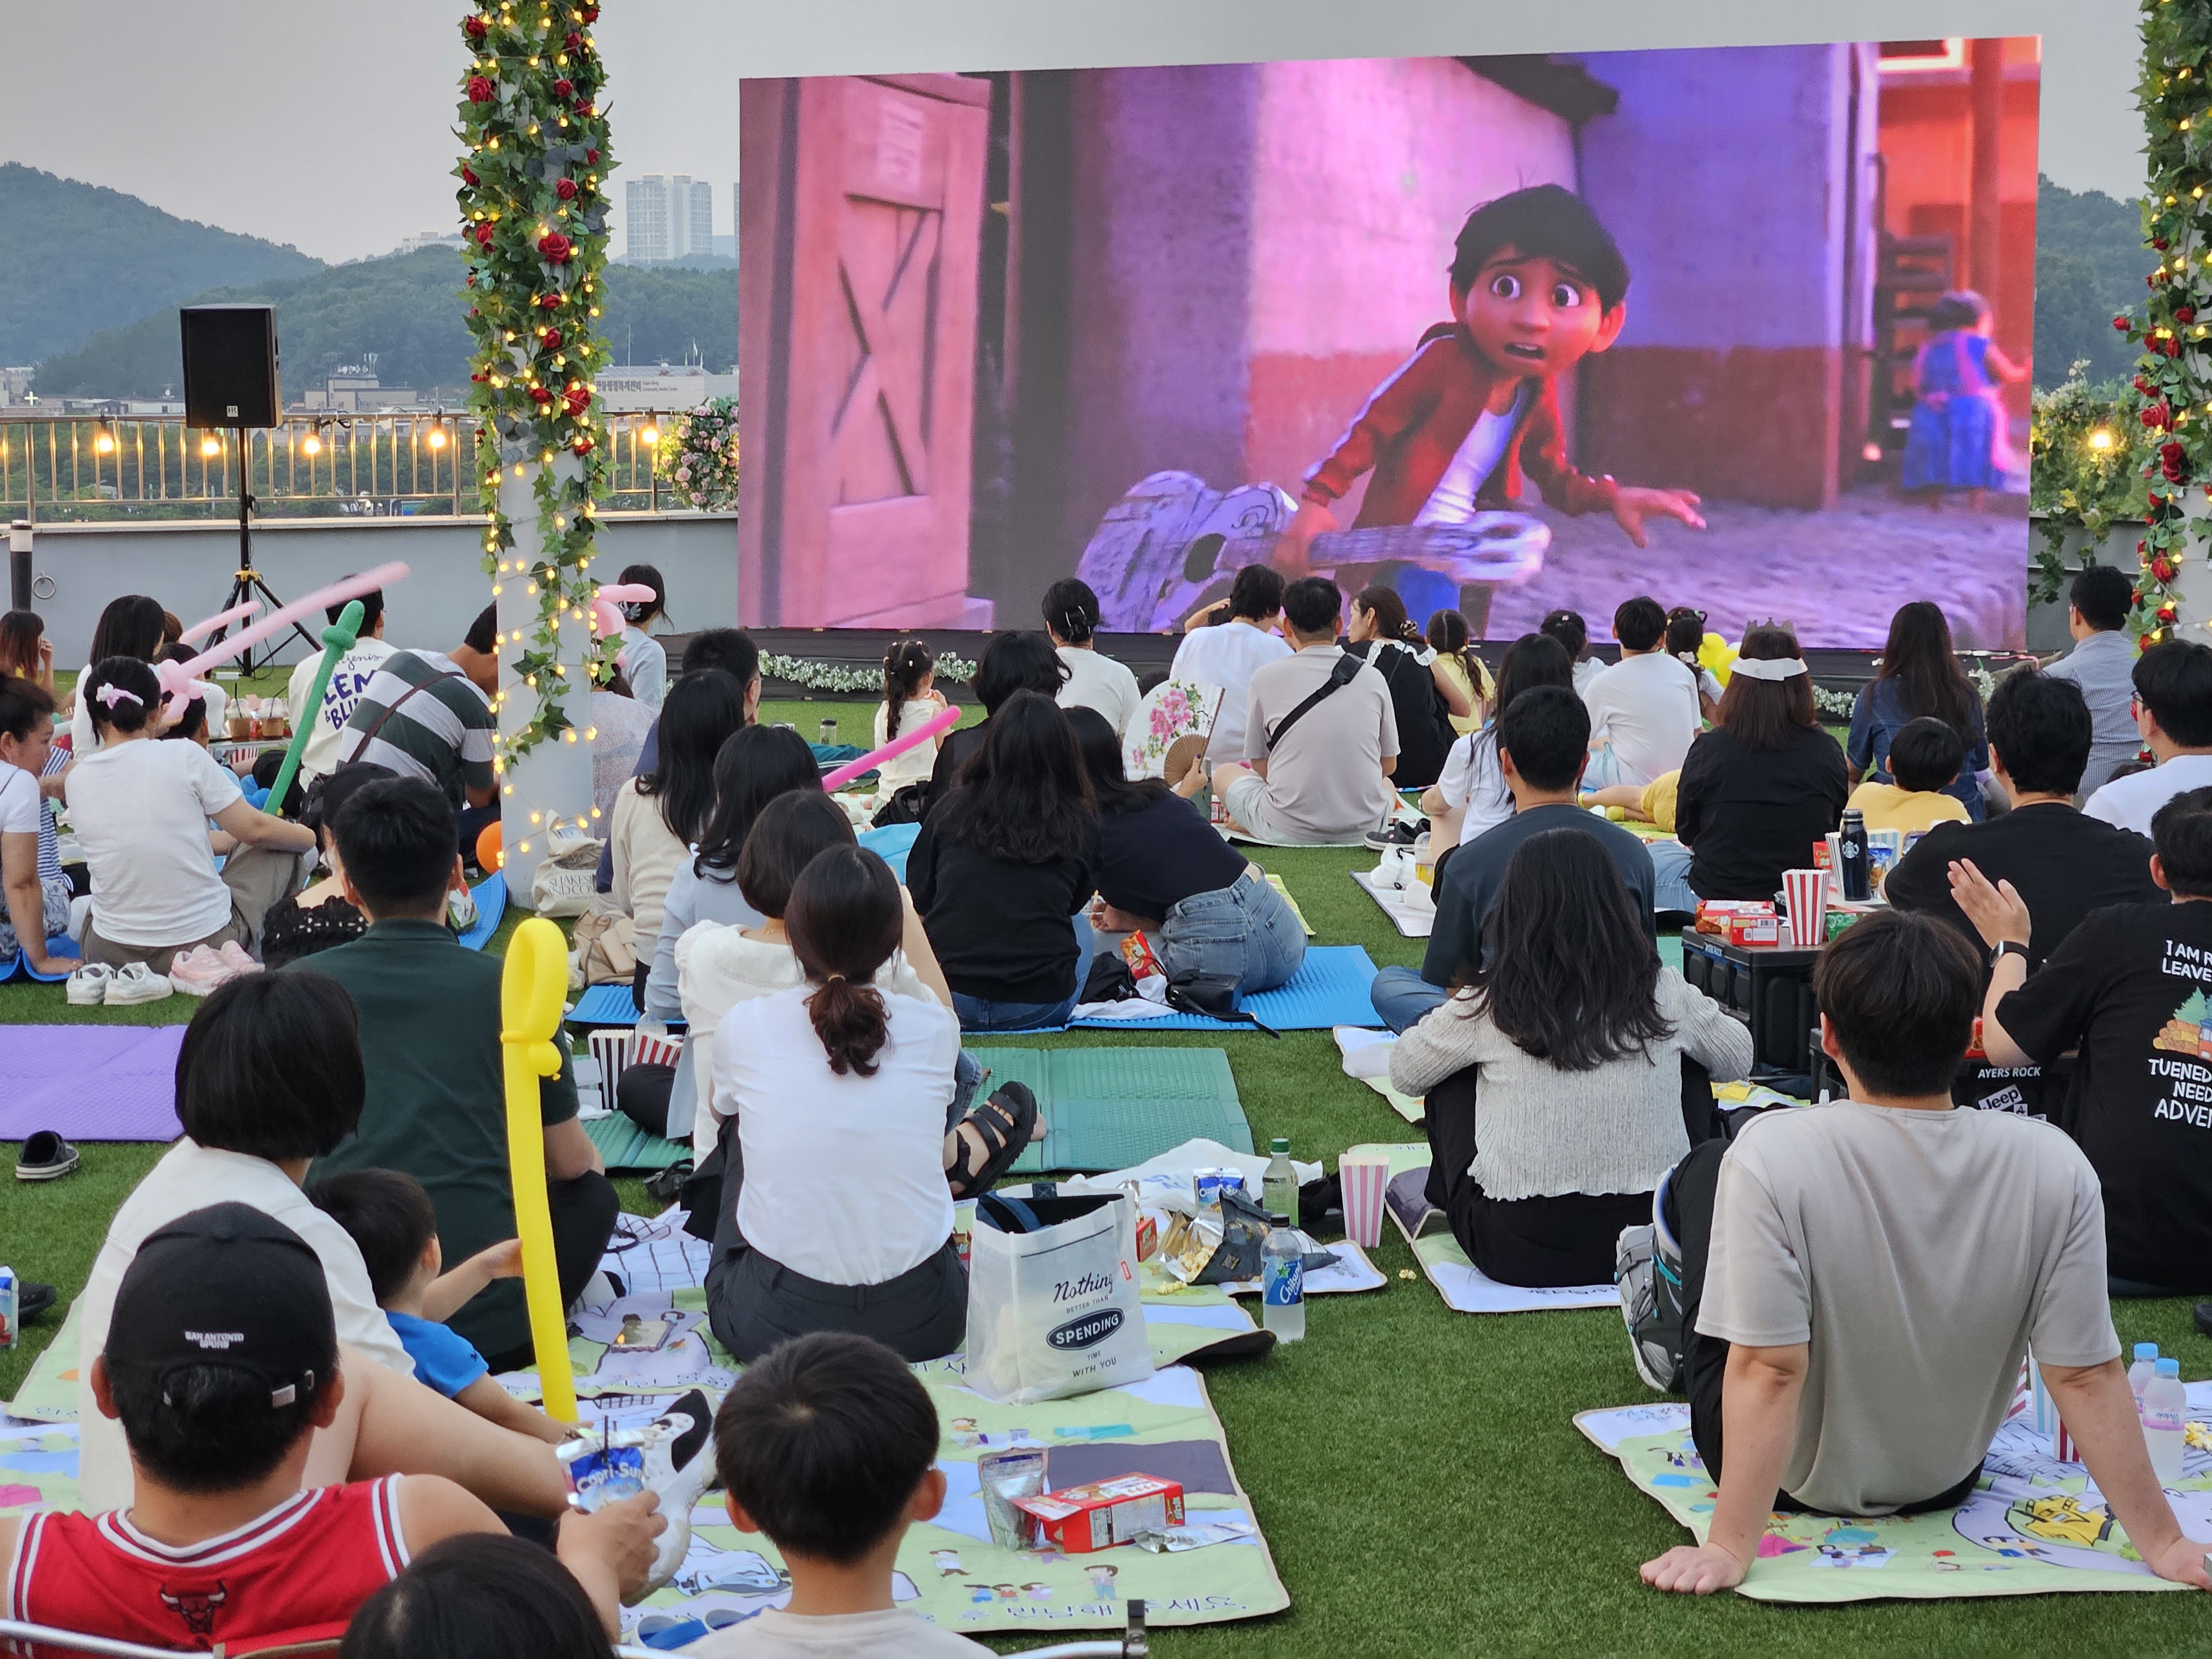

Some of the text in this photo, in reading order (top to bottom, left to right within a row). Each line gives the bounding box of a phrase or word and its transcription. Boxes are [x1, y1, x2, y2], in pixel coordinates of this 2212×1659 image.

[2166, 940, 2173, 956] I
[2175, 943, 2199, 963] AM
[2162, 957, 2212, 982] LEAVE
[1978, 1066, 2041, 1078] AYERS ROCK
[2148, 1058, 2212, 1083] TUENED
[1982, 1089, 2019, 1109] Jeep
[2173, 1081, 2212, 1103] NEED
[1053, 1272, 1113, 1303] Nothing
[1280, 1261, 1301, 1303] Chilsung
[1067, 1295, 1109, 1314] BETTER THAN
[185, 1331, 244, 1342] SAN ANTONIO
[1056, 1313, 1119, 1344] SPENDING
[1087, 1350, 1102, 1361] TIME
[1072, 1357, 1117, 1378] WITH YOU
